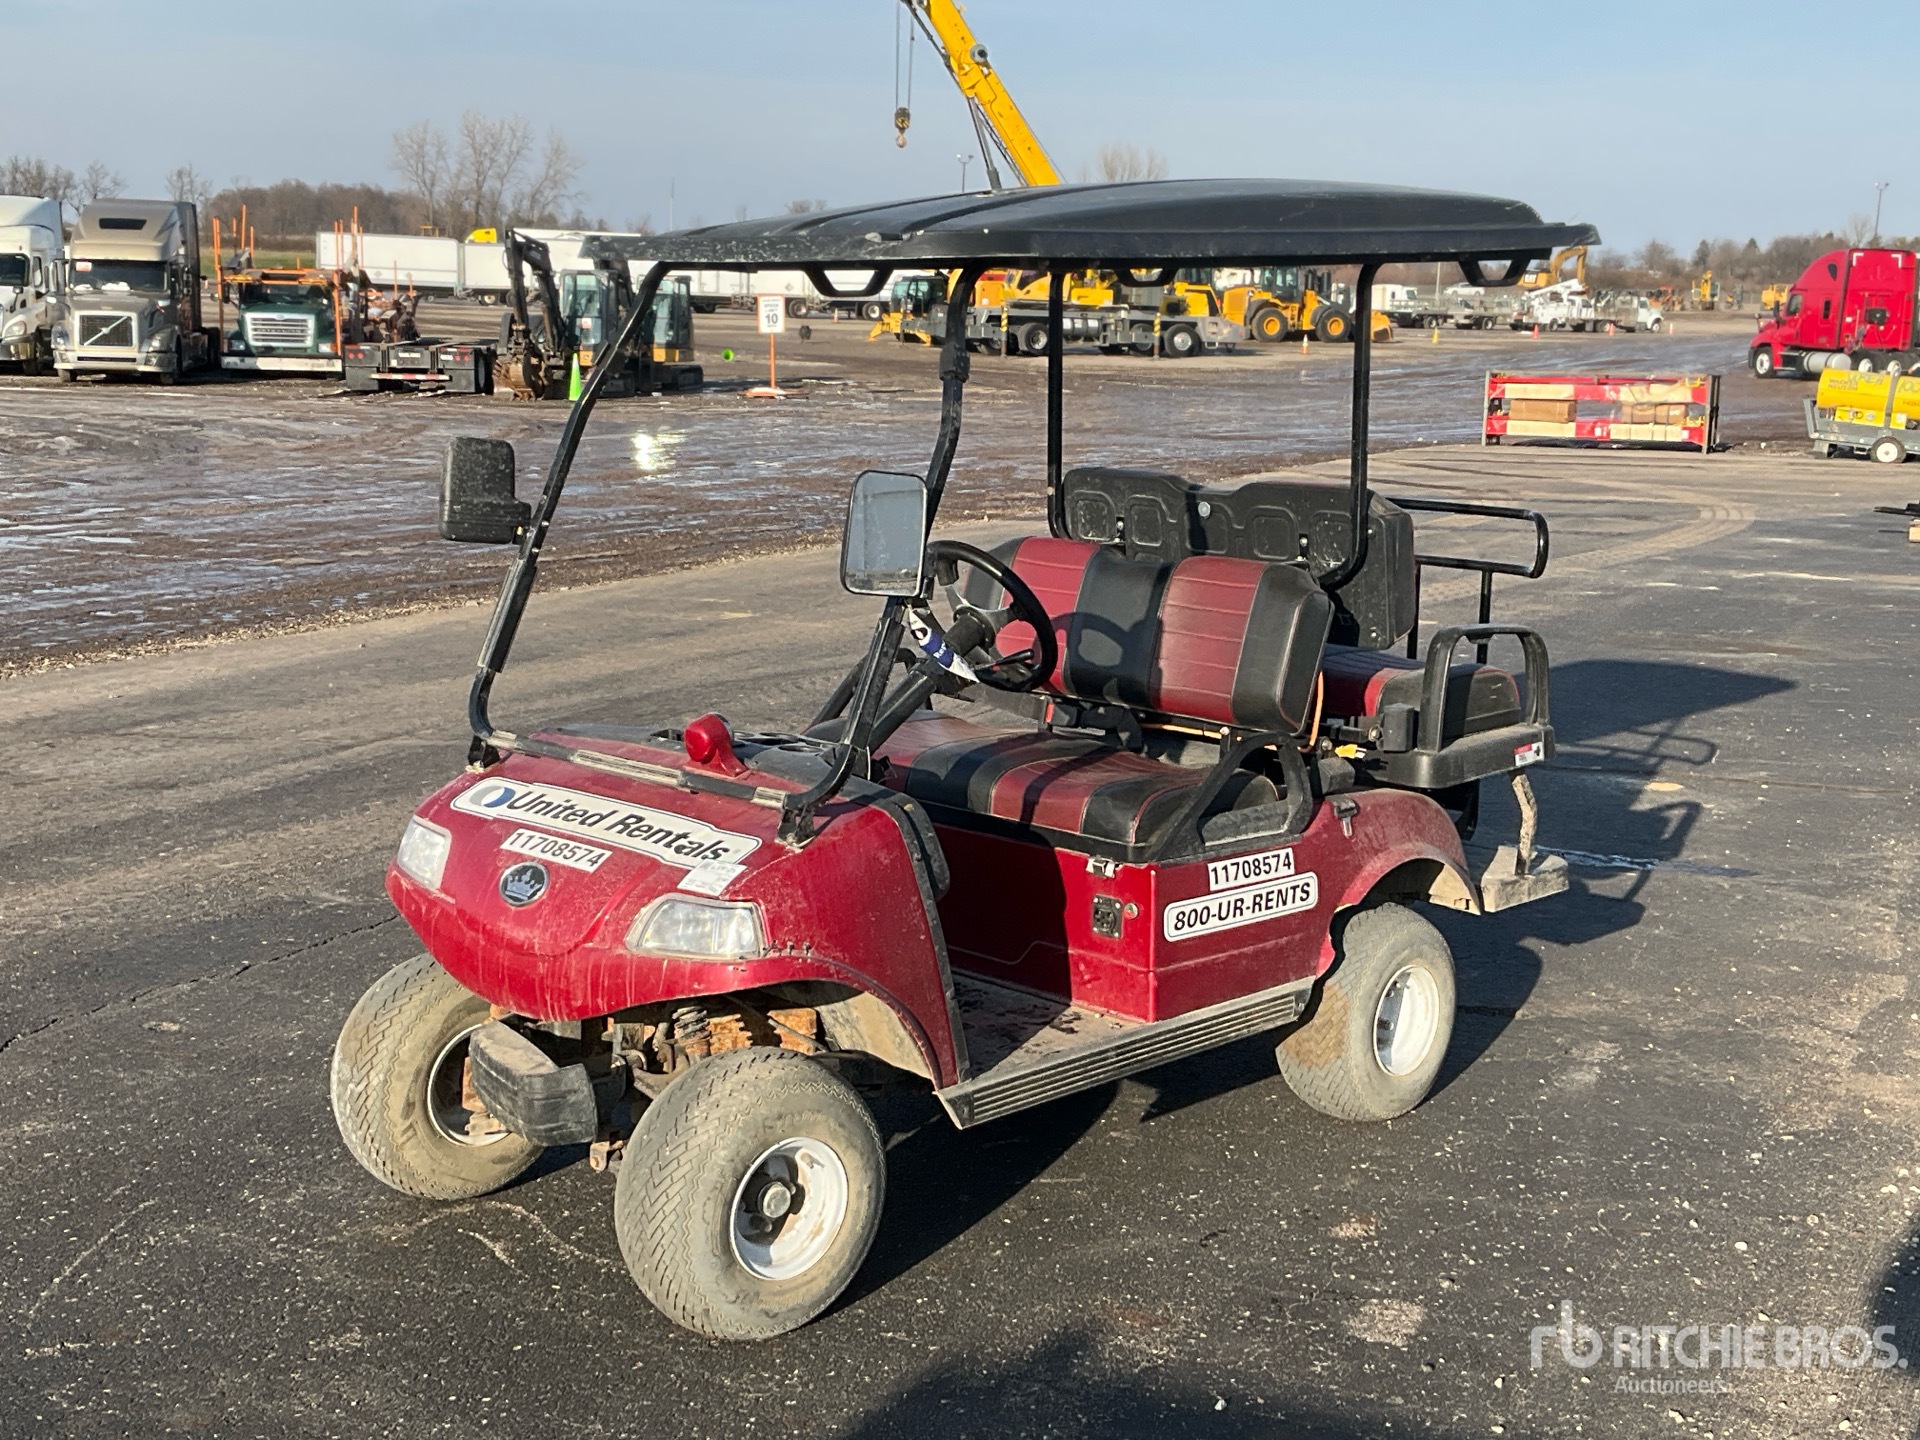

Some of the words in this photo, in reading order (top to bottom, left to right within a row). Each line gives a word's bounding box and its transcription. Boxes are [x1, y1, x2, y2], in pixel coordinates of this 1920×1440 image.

[765, 313, 778, 324] 10
[506, 791, 618, 827] United
[605, 813, 730, 860] Rentals
[507, 831, 605, 867] 11708574
[1211, 851, 1292, 885] 11708574
[1174, 881, 1311, 931] 800-UR-RENTS
